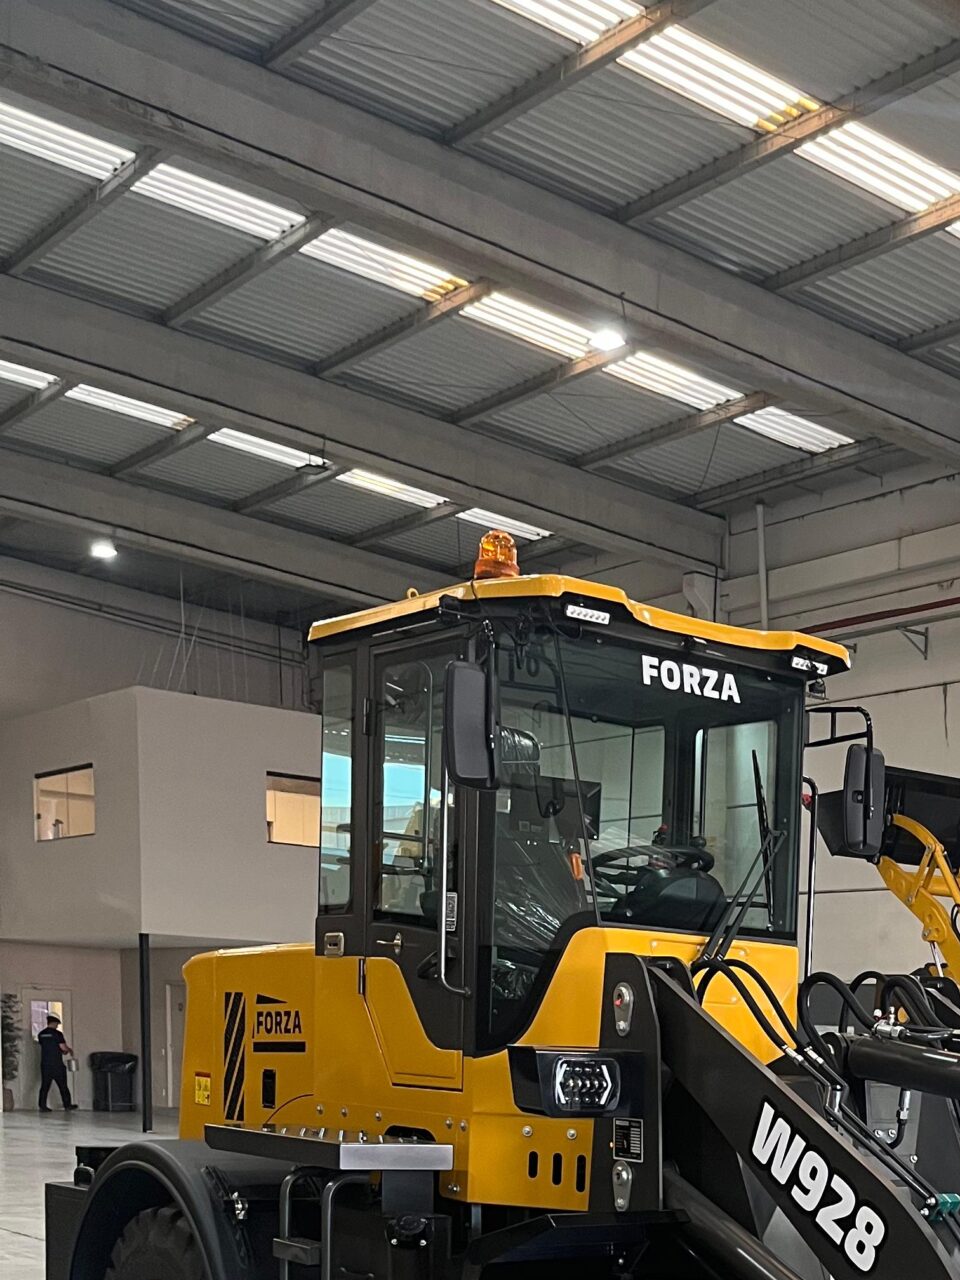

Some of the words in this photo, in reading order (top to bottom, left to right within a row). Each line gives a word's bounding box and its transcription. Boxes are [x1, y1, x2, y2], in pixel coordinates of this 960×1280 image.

[641, 654, 741, 704] FORZA
[256, 1010, 302, 1034] FORZA
[752, 1101, 886, 1272] W928
